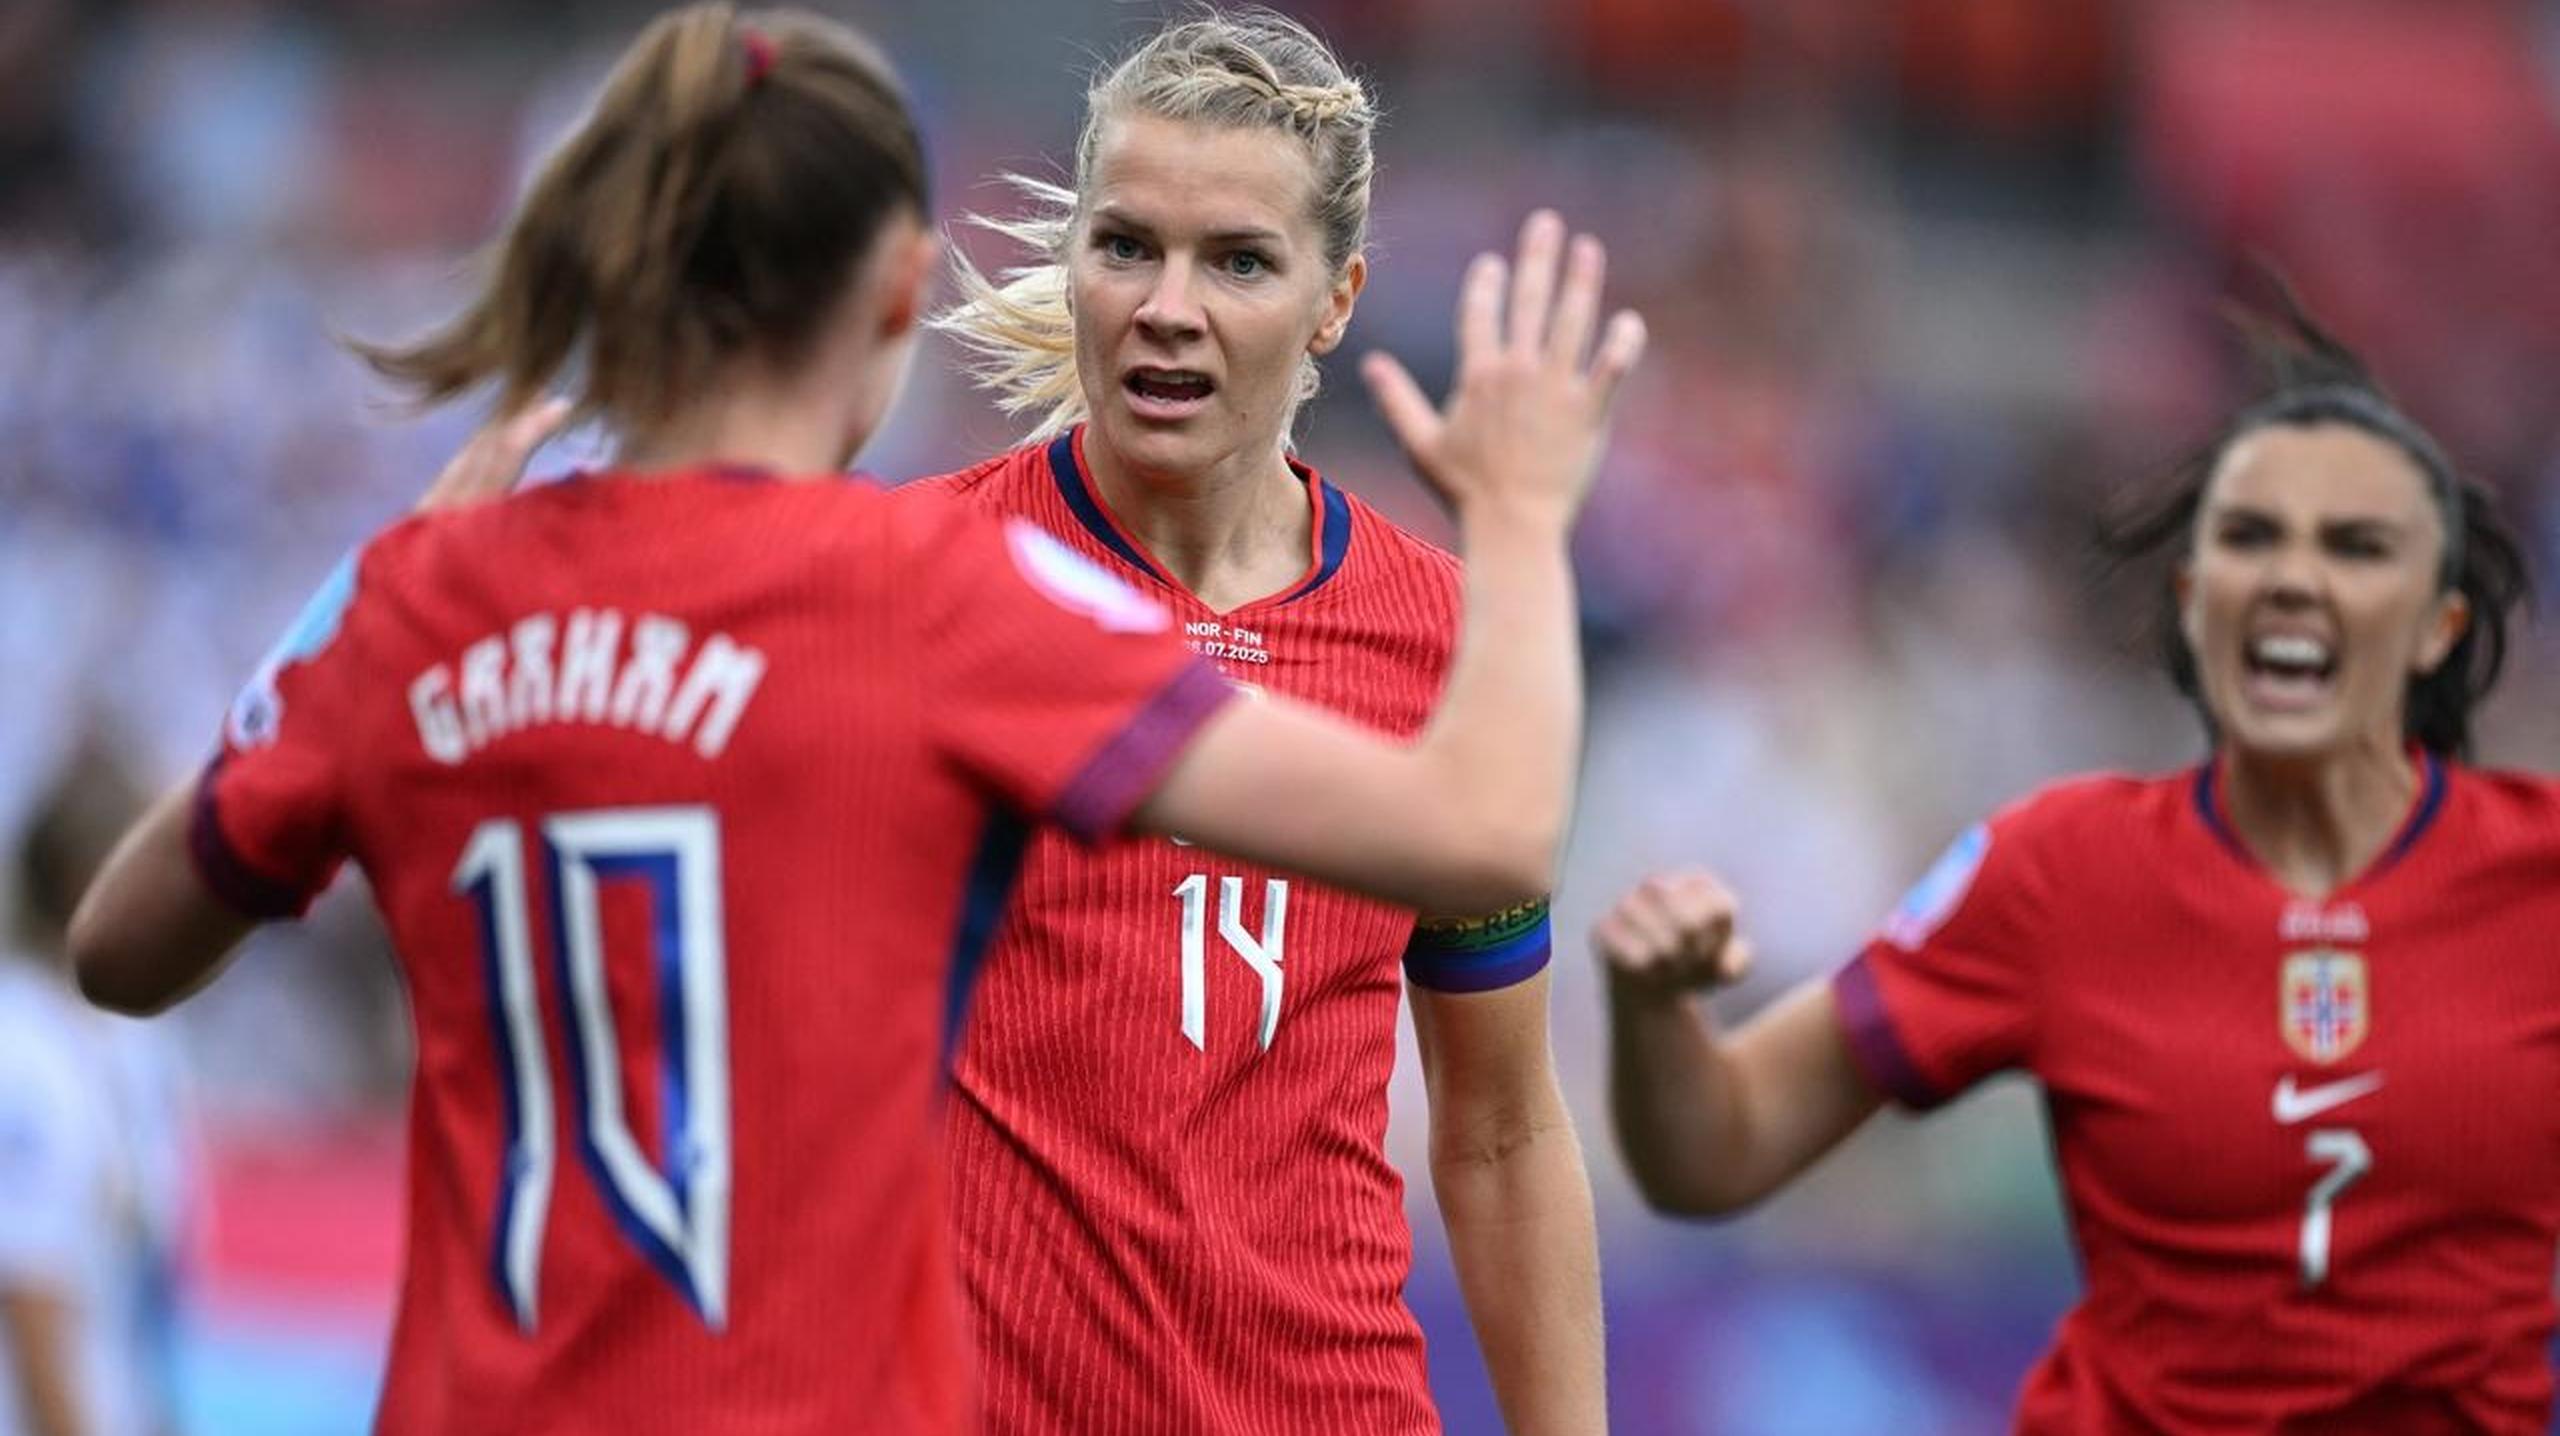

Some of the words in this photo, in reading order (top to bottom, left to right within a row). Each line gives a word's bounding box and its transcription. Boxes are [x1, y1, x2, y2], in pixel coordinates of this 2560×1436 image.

[409, 606, 767, 765] GRAHAM
[1185, 622, 1221, 638] NOR
[1233, 628, 1262, 645] FIN
[1172, 874, 1288, 1053] 14
[450, 806, 732, 1335] 10
[2300, 1128, 2374, 1284] 7
